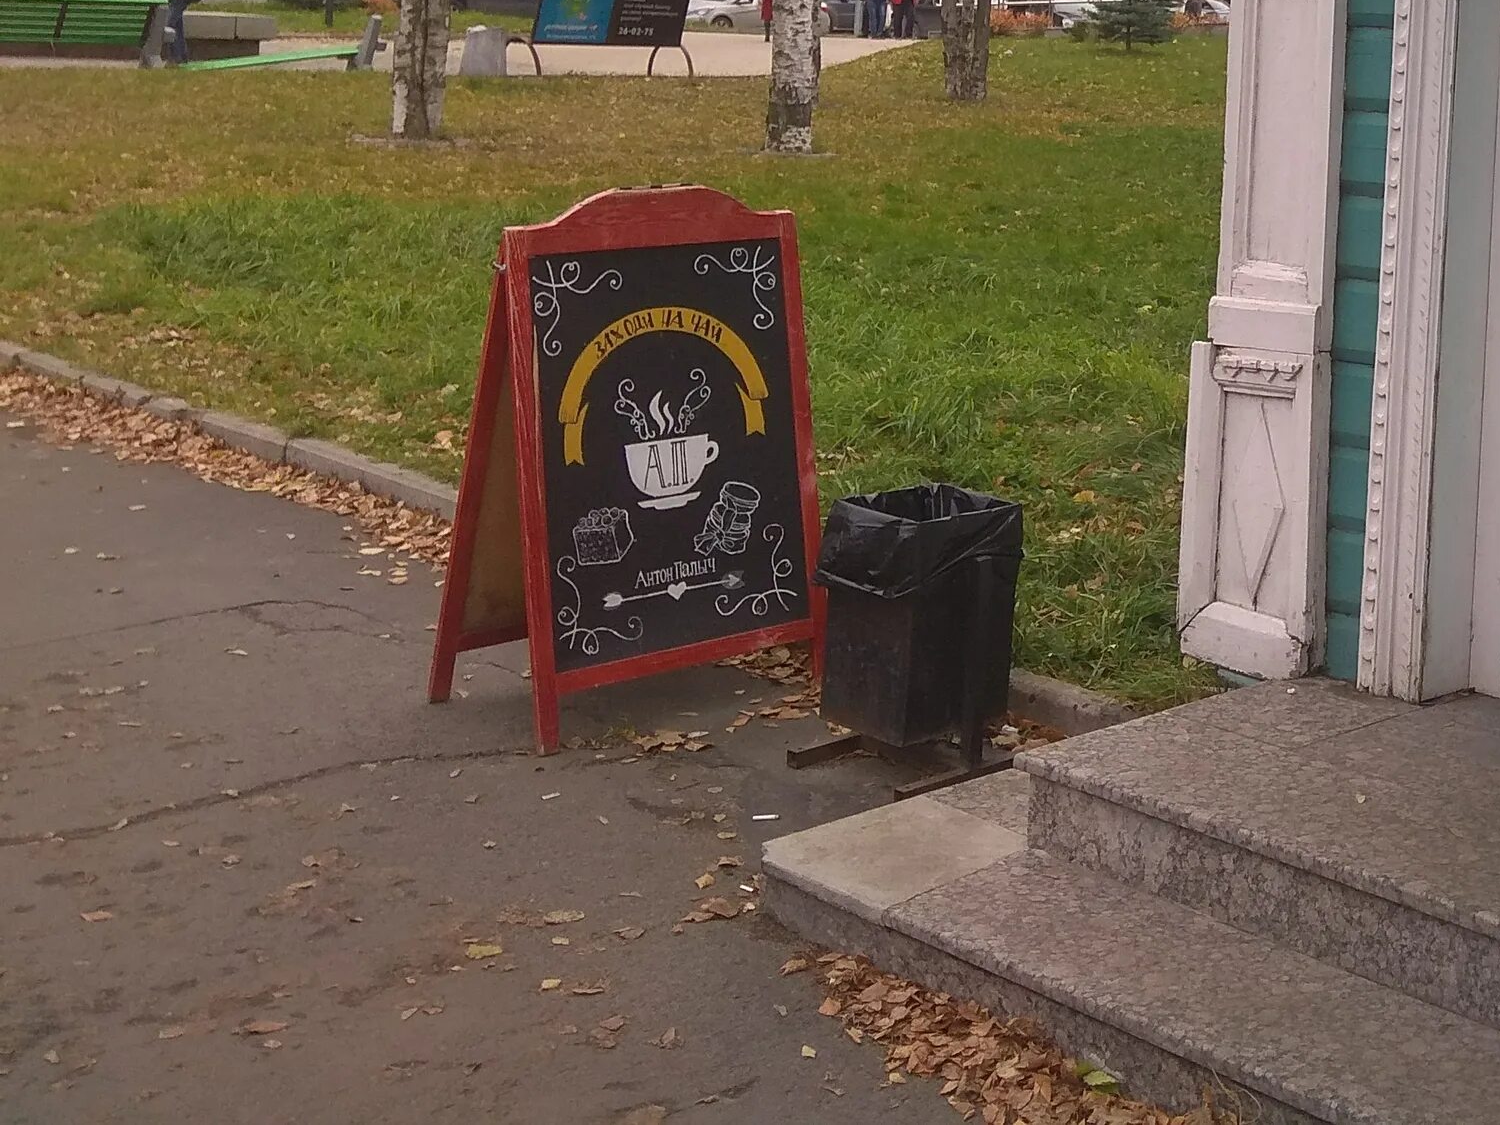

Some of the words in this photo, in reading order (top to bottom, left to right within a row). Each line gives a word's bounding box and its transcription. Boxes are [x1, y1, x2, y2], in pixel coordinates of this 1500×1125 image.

[594, 312, 655, 360] ЗАХОДИ
[661, 309, 684, 329] НА
[691, 312, 722, 344] ЧАЙ
